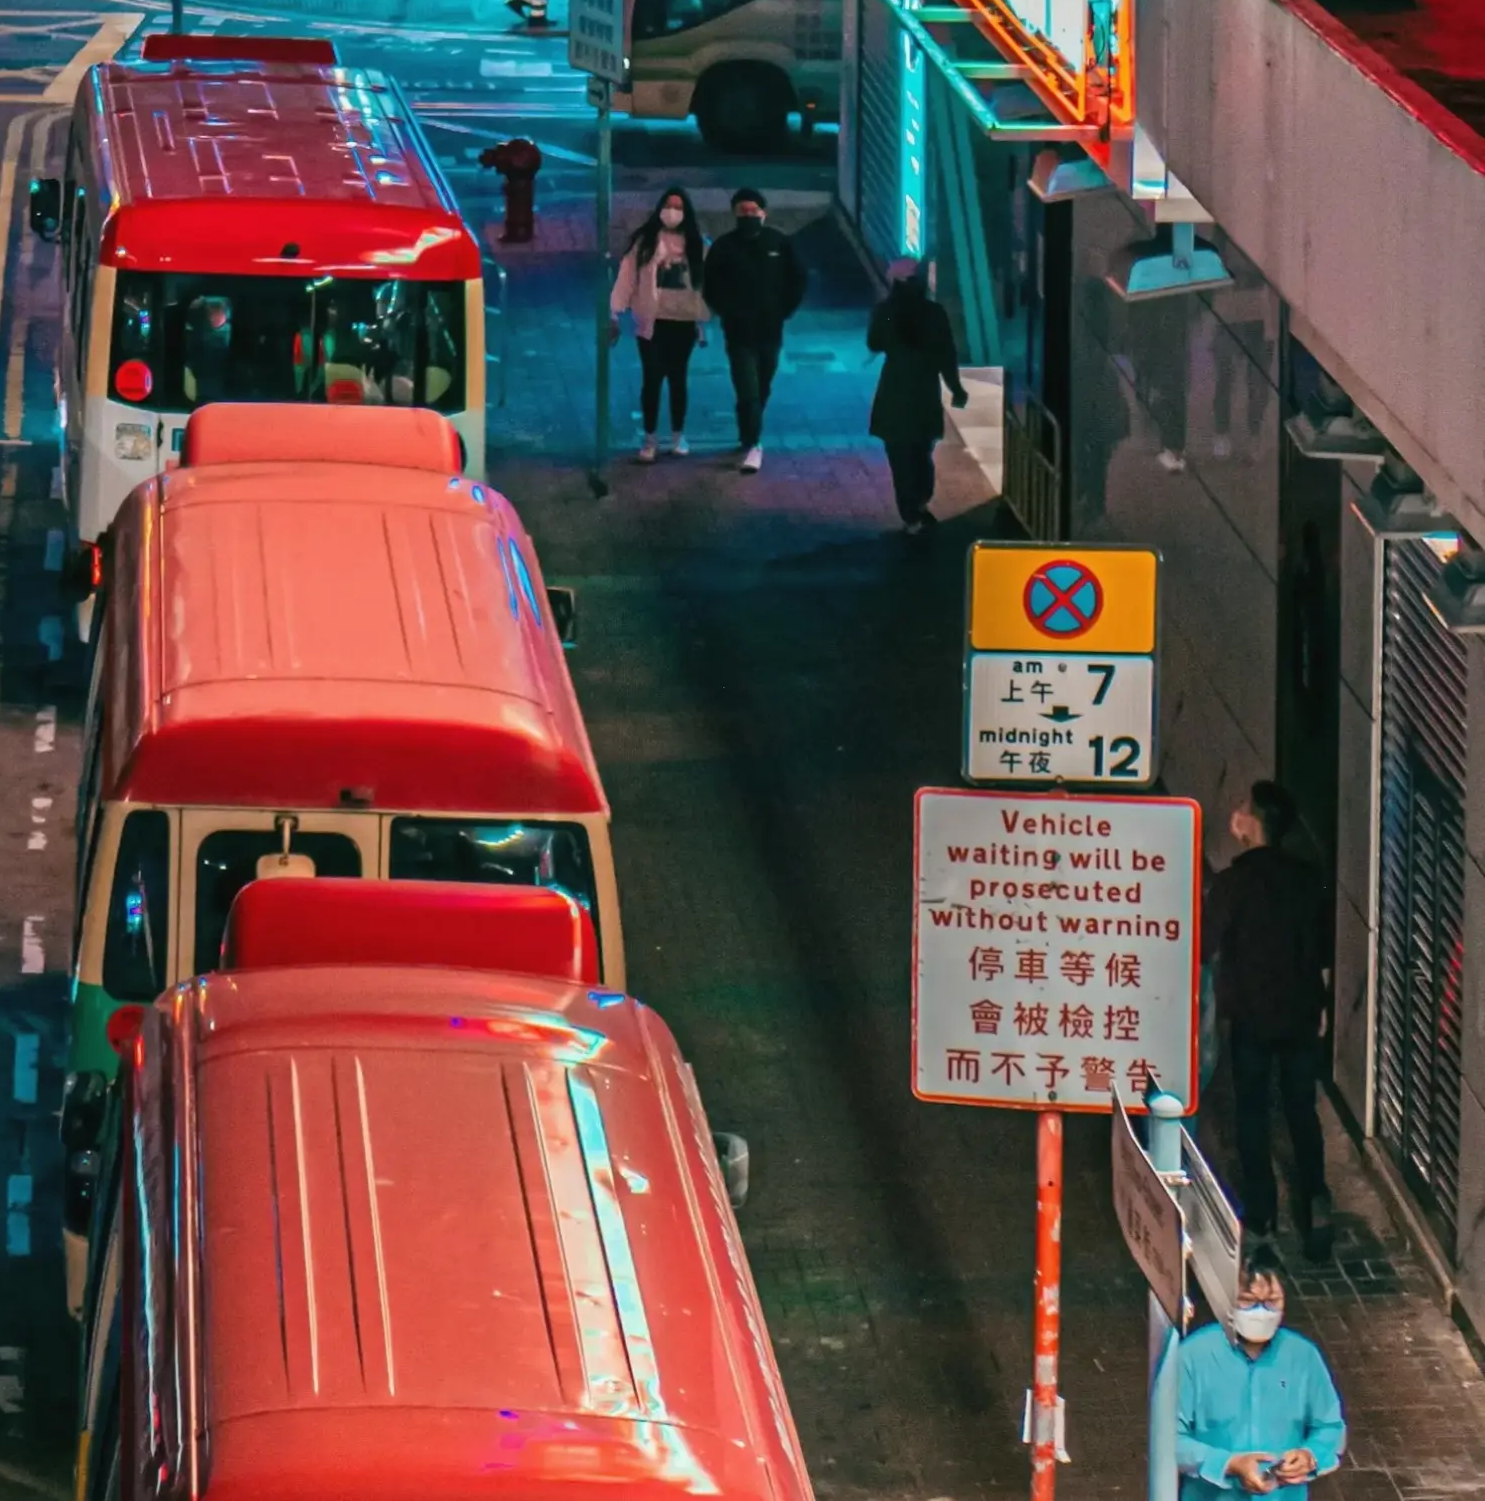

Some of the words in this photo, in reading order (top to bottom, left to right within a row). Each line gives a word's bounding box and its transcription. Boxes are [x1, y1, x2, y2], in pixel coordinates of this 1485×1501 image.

[1012, 660, 1043, 675] am
[1000, 680, 1054, 704] 上午
[1087, 664, 1117, 705] 7
[979, 727, 1074, 747] midnight
[999, 750, 1053, 775] 午夜
[1088, 735, 1142, 777] 12
[1001, 809, 1112, 838] Vehicle
[947, 842, 1059, 870] waiting
[1069, 844, 1121, 871] will
[1132, 847, 1166, 872] be
[969, 877, 1142, 904] prosecuted
[931, 906, 1047, 932] without
[1060, 914, 1181, 941] warning
[968, 946, 1142, 988] 停車等候
[968, 1000, 1141, 1042] 會被檢控
[946, 1050, 1162, 1093] 而不予警告
